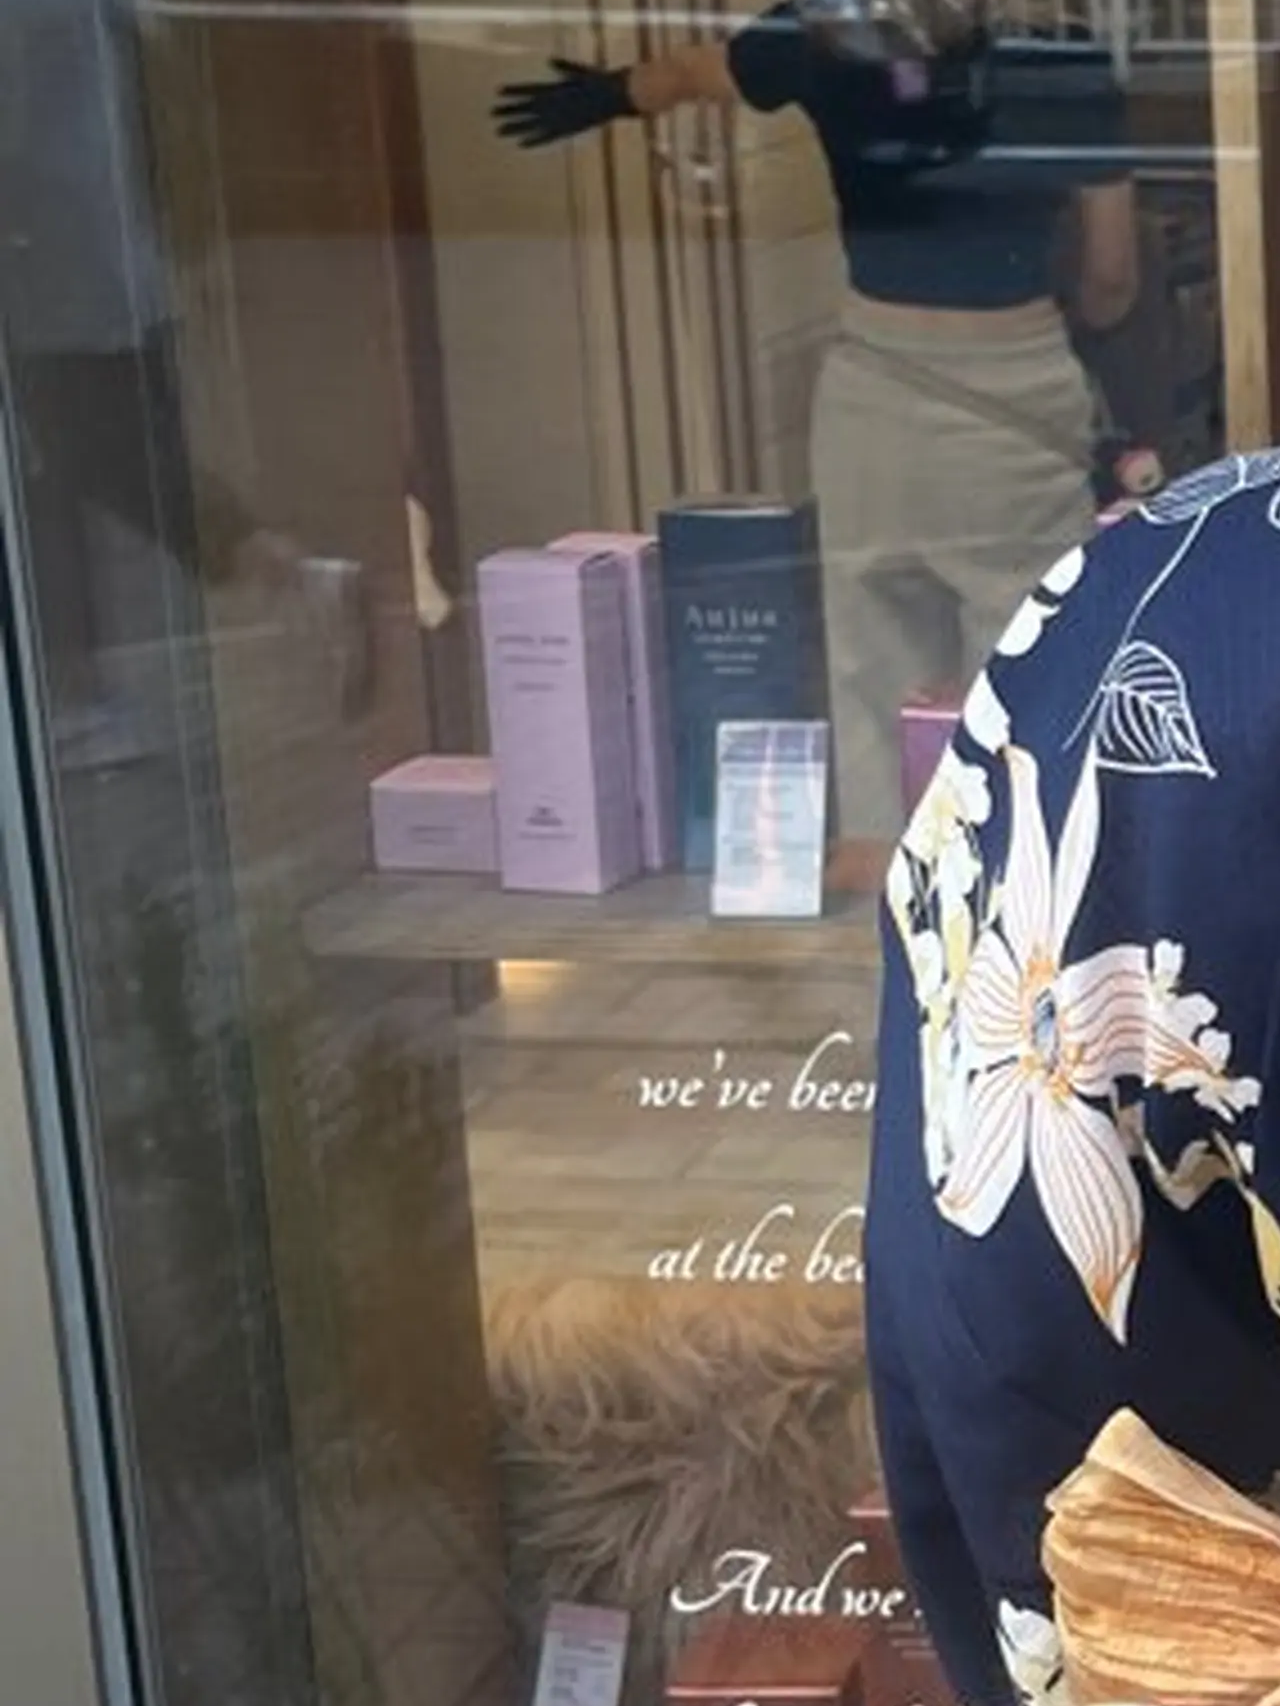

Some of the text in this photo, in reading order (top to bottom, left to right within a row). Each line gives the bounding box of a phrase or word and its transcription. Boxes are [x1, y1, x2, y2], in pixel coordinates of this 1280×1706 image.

[638, 1050, 771, 1108] we've
[648, 1239, 702, 1280] at
[714, 1205, 794, 1281] the
[671, 1542, 905, 1617] And we
